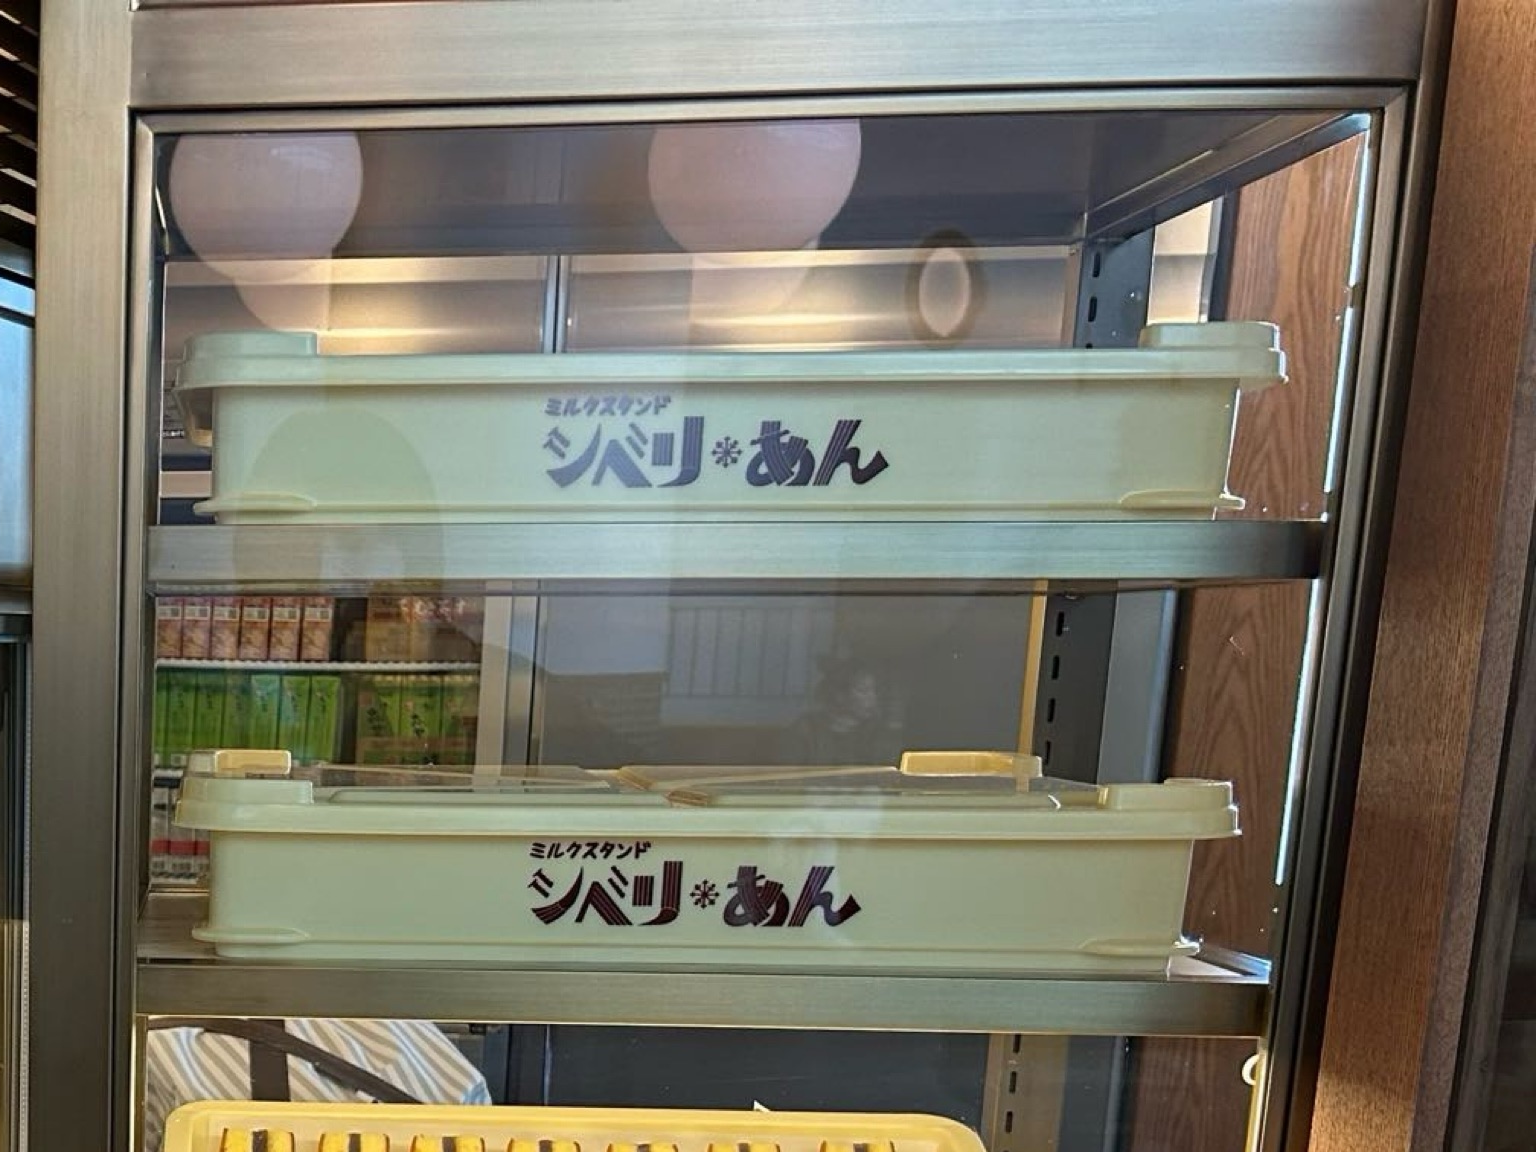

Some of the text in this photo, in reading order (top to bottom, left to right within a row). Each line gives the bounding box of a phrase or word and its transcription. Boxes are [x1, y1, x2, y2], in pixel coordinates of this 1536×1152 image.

[544, 395, 671, 416] ミルクスタンド
[529, 841, 651, 860] ミルクスタンド
